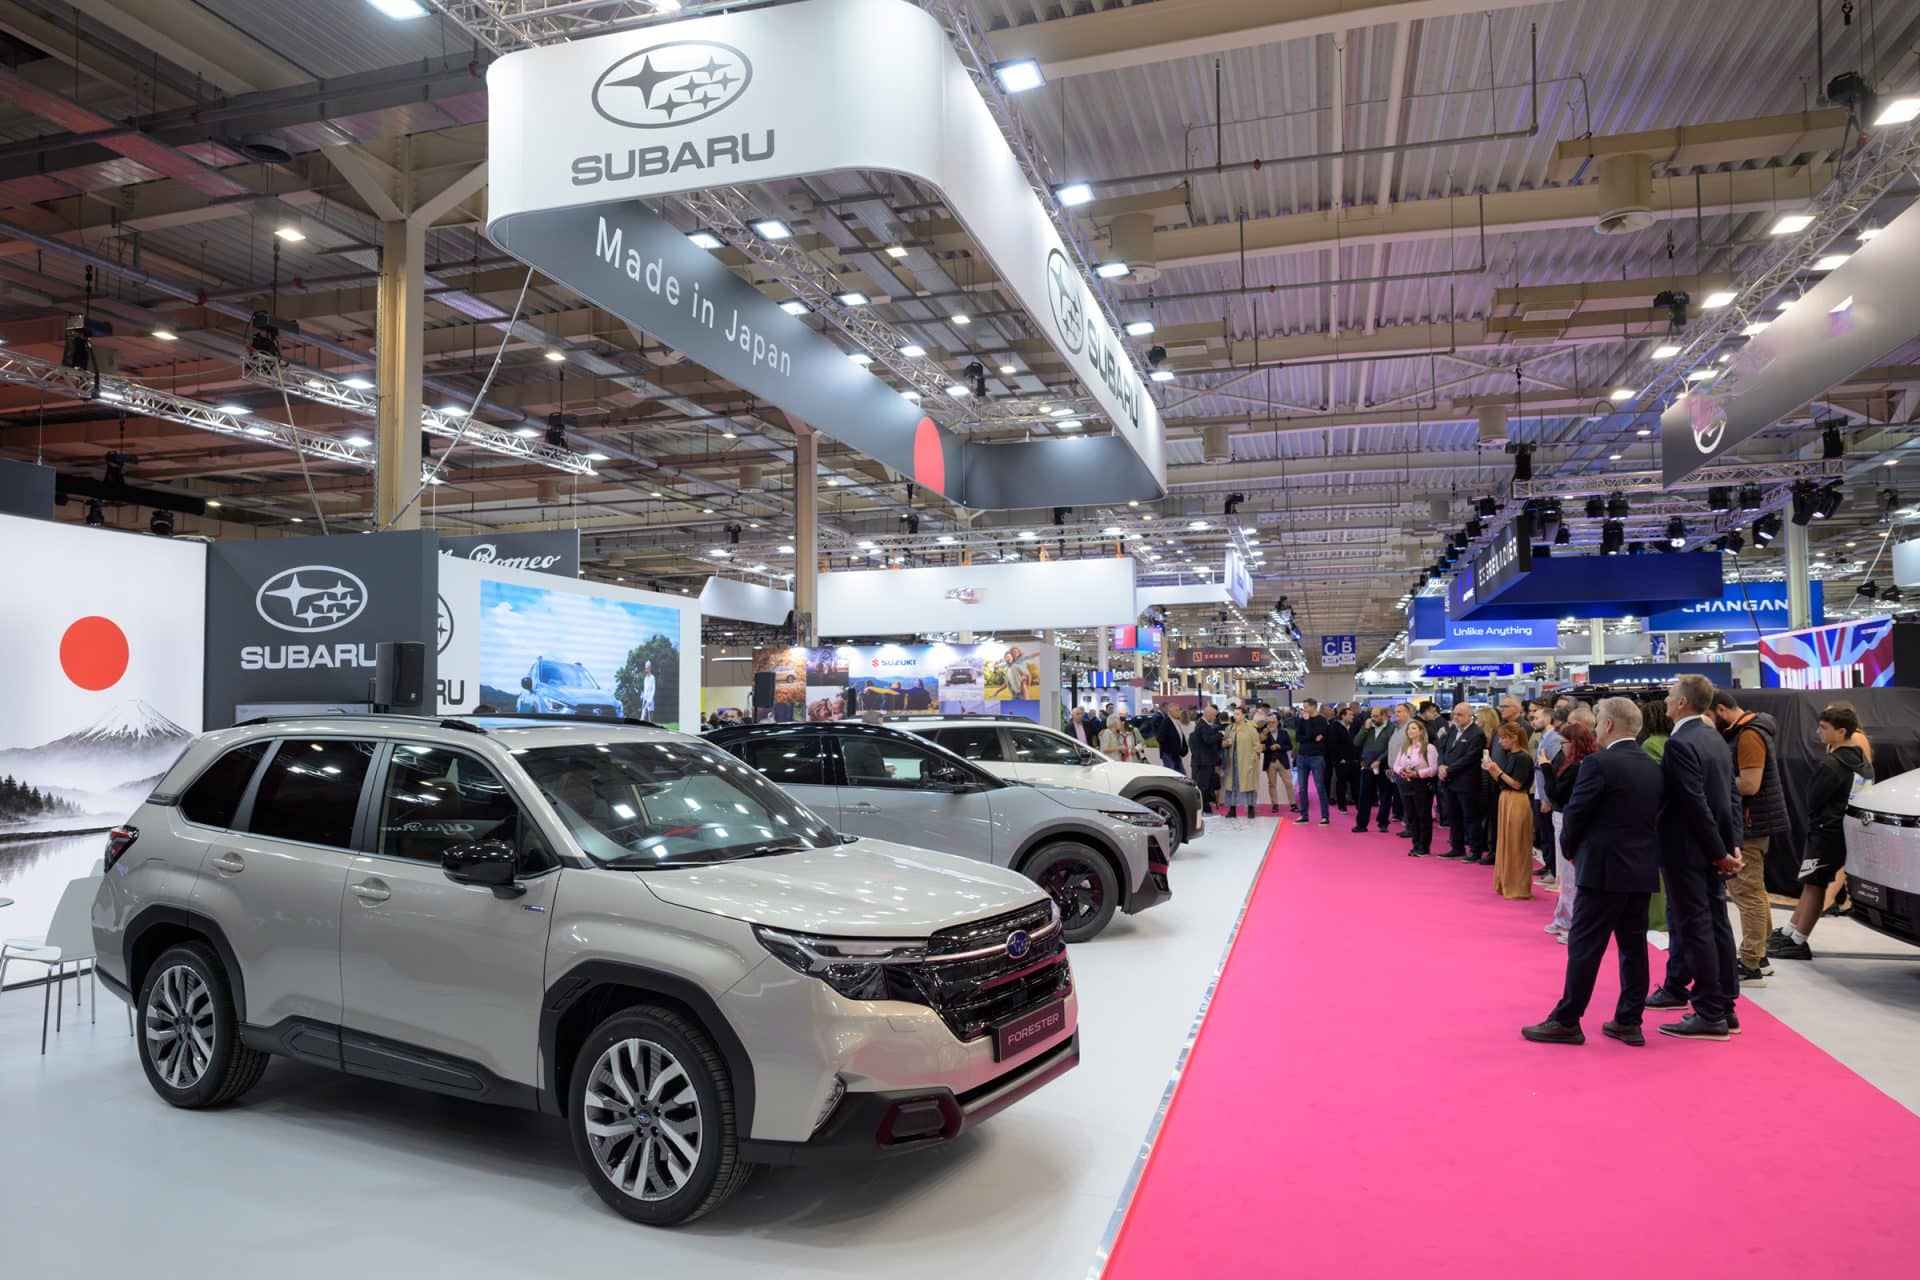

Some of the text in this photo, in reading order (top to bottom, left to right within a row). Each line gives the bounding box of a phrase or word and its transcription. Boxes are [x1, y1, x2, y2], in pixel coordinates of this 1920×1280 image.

[572, 129, 775, 186] SUBARU
[596, 216, 791, 377] Made in Japan
[1088, 318, 1139, 428] SUBARU
[1453, 626, 1533, 637] Unlike Anything
[1324, 642, 1337, 656] C
[1341, 641, 1352, 653] B
[881, 659, 917, 667] SUZUKI
[1007, 1012, 1059, 1046] FORESTER
